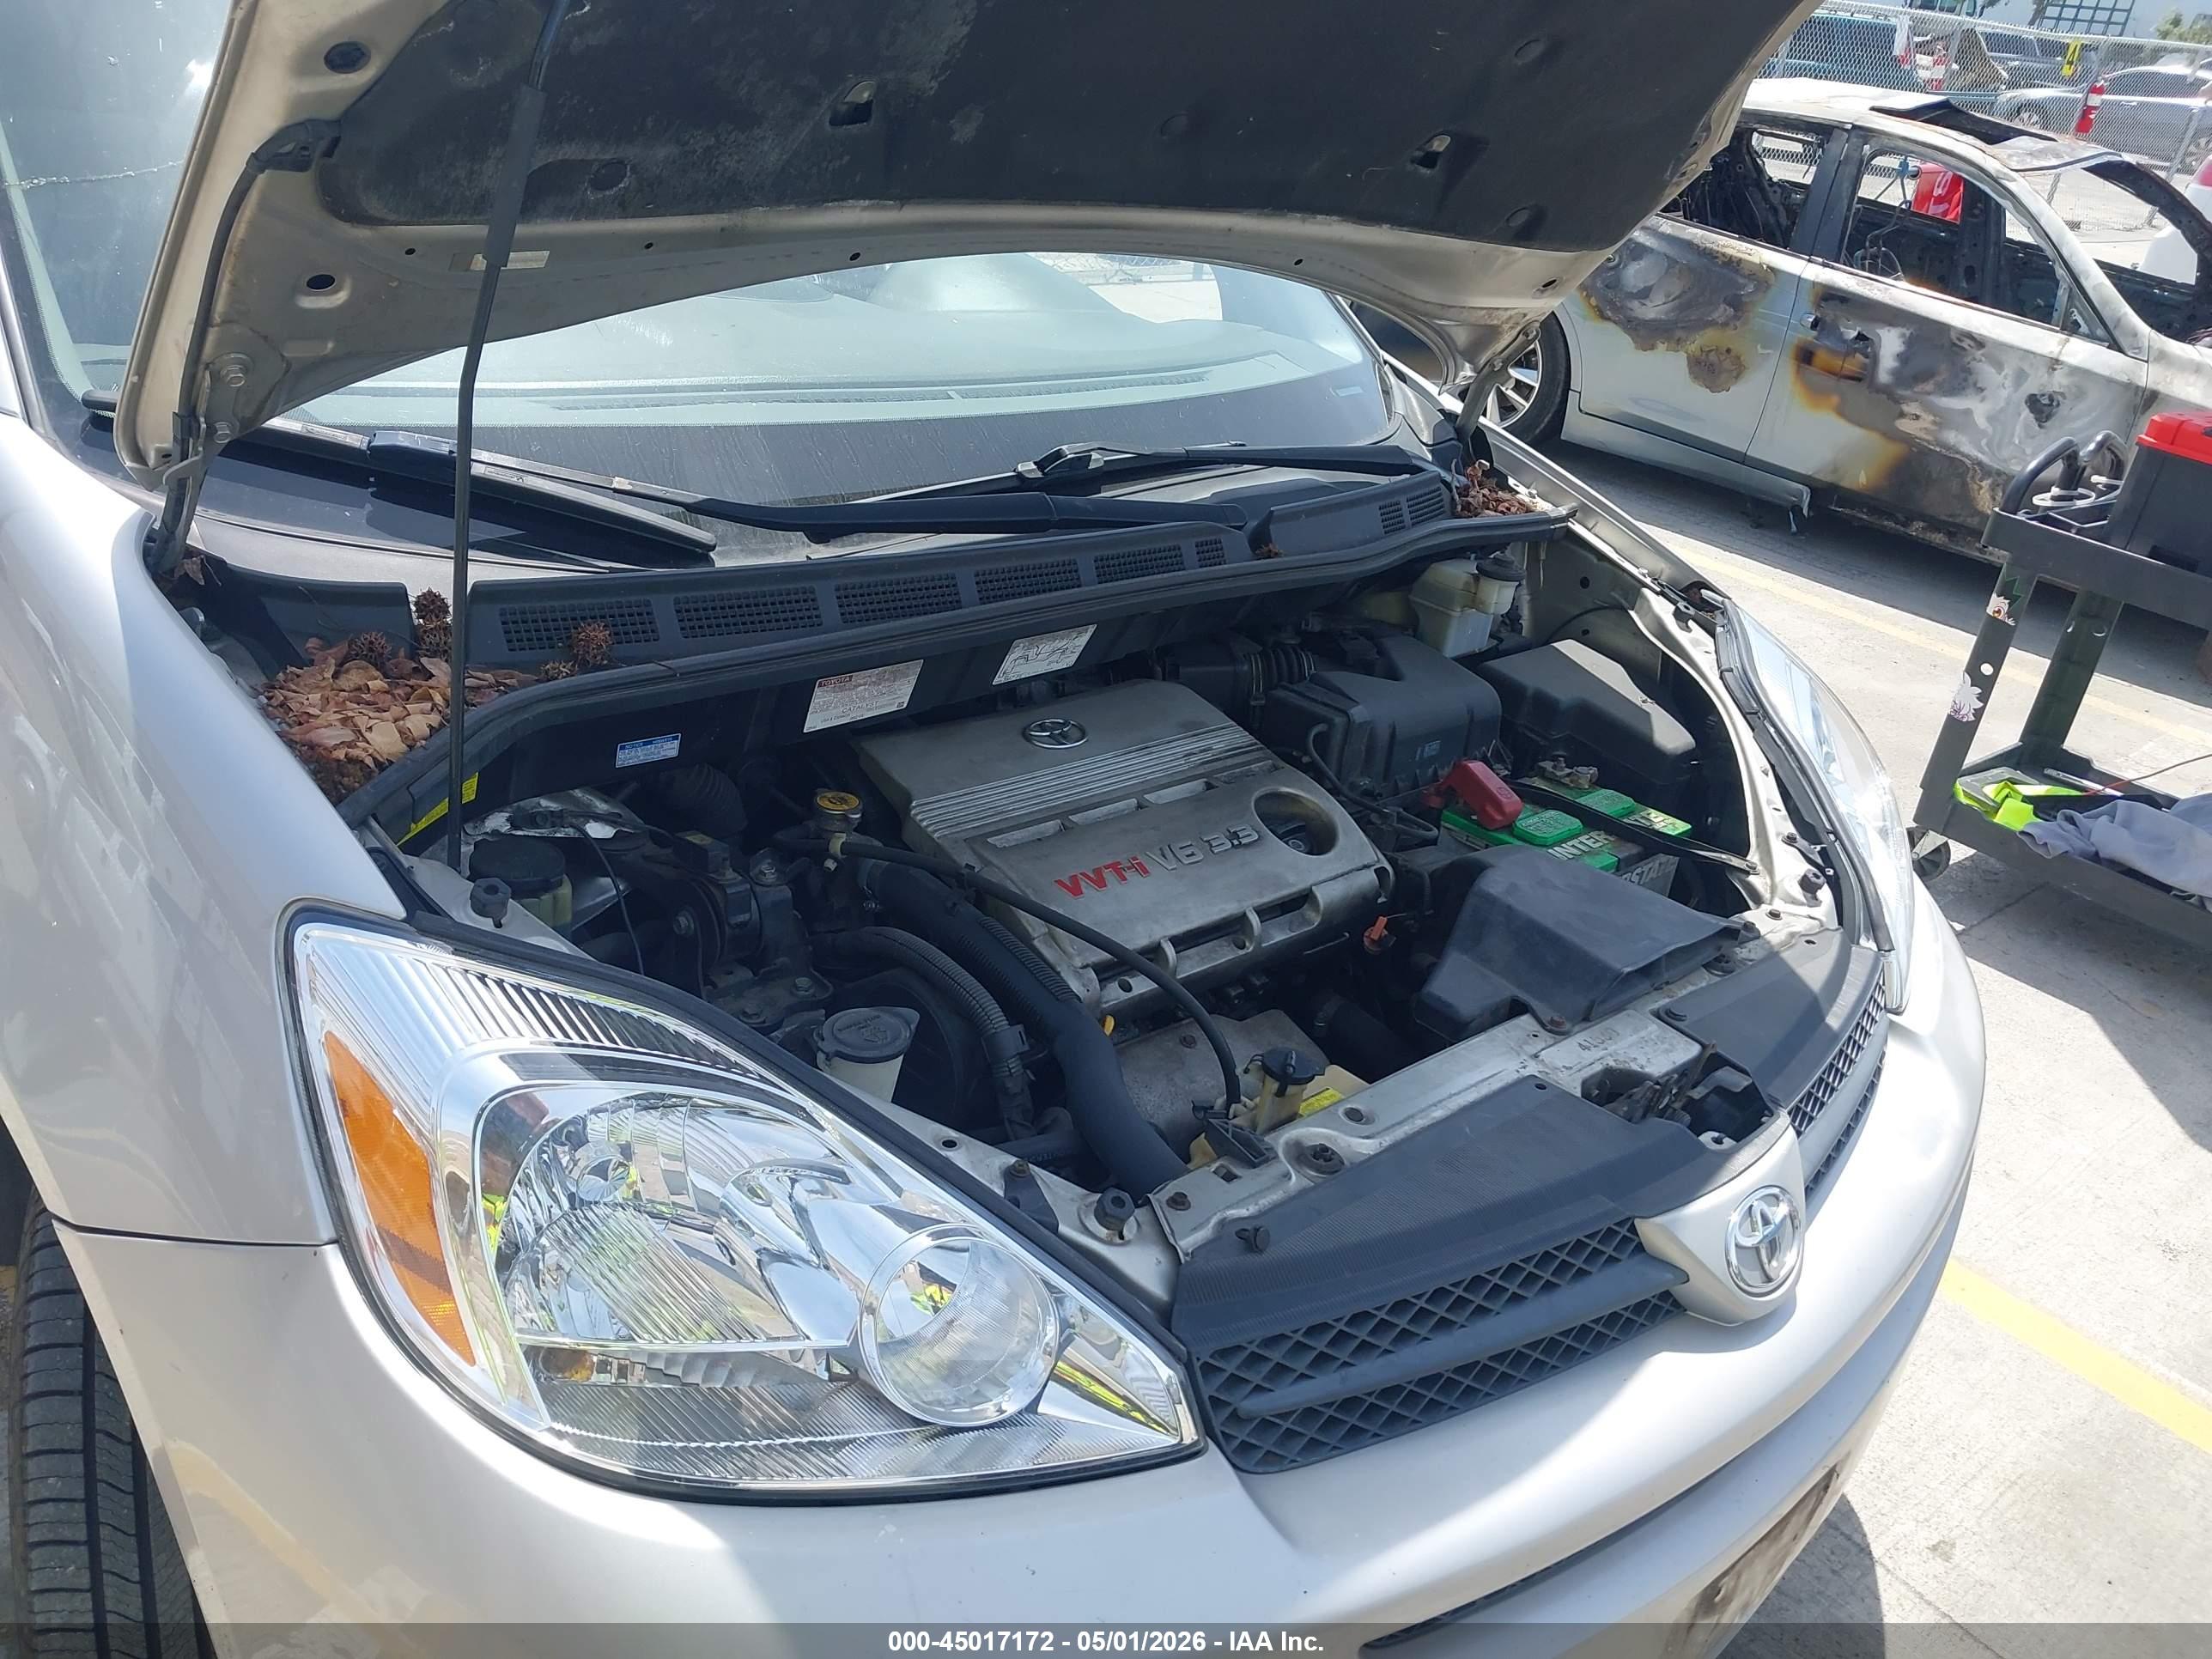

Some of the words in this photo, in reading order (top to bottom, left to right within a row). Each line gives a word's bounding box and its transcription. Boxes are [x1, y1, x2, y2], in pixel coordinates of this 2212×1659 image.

[821, 677, 849, 686] TOYOTA
[842, 700, 880, 714] CATALYST
[1054, 855, 1151, 899] VVT-i
[1146, 841, 1204, 872] V6
[1200, 823, 1260, 854] 3.3
